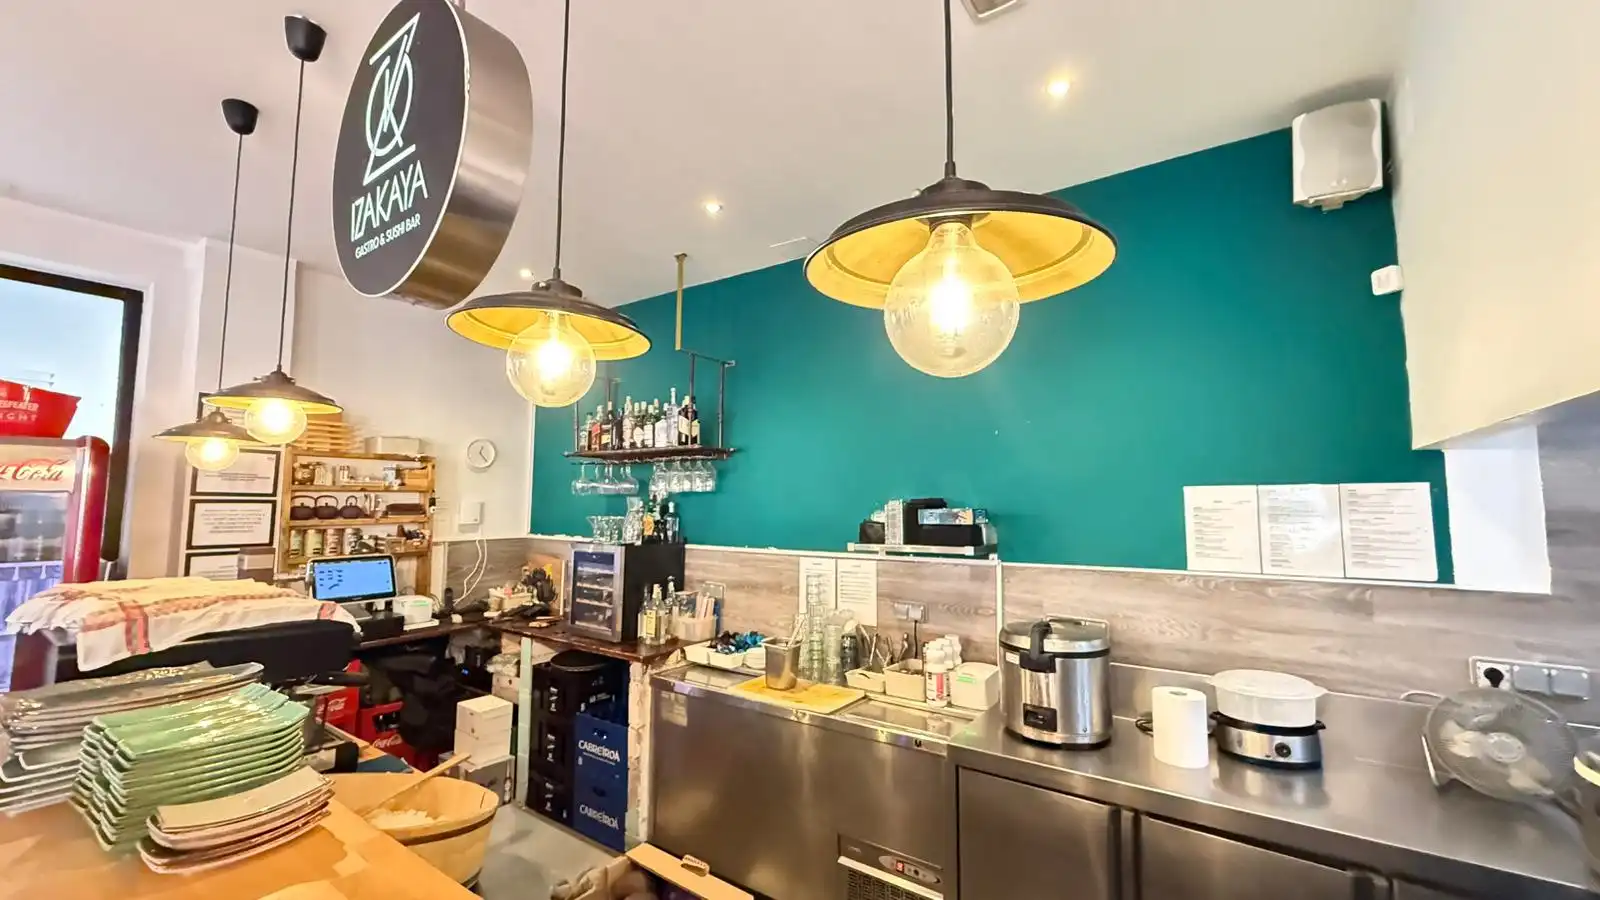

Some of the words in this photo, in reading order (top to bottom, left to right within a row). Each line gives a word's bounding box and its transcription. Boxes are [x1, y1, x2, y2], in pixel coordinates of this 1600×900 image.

[351, 159, 429, 242] IZAKAYA
[355, 236, 379, 259] GASTRO
[379, 233, 386, 246] &
[385, 221, 405, 243] SUSHI
[405, 213, 421, 232] BAR
